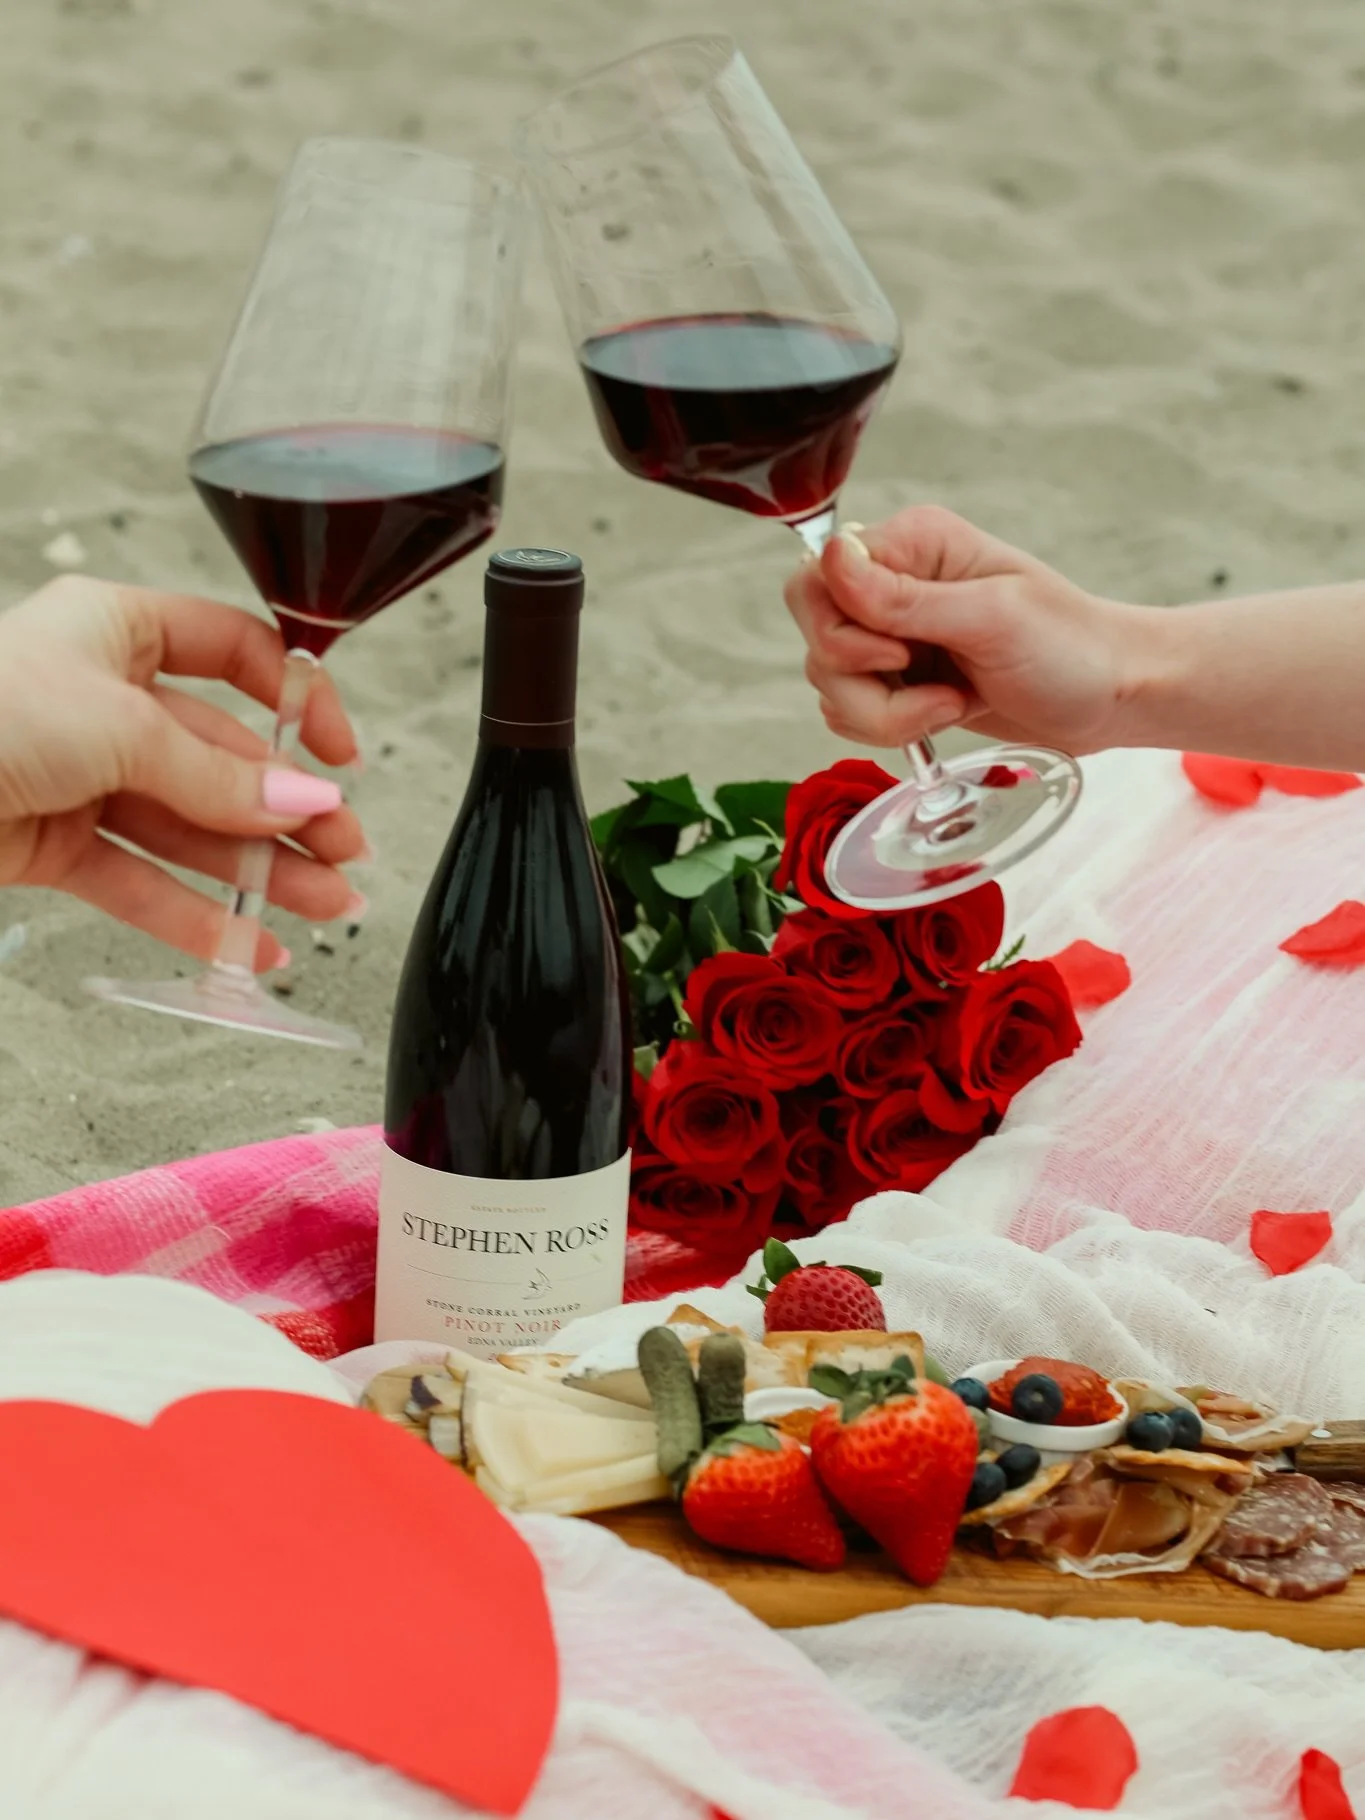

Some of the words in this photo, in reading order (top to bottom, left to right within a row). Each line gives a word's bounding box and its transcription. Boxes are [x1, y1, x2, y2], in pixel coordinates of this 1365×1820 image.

[402, 1211, 537, 1254] STEPHEN
[545, 1217, 609, 1253] ROSS
[426, 1299, 463, 1313] STONE
[468, 1306, 518, 1317] CORRAL
[524, 1303, 581, 1316] VINEYARD
[444, 1315, 505, 1334] PINOT
[515, 1319, 562, 1334] NOIR
[467, 1336, 496, 1346] EDNA
[499, 1337, 538, 1347] VALLEY
